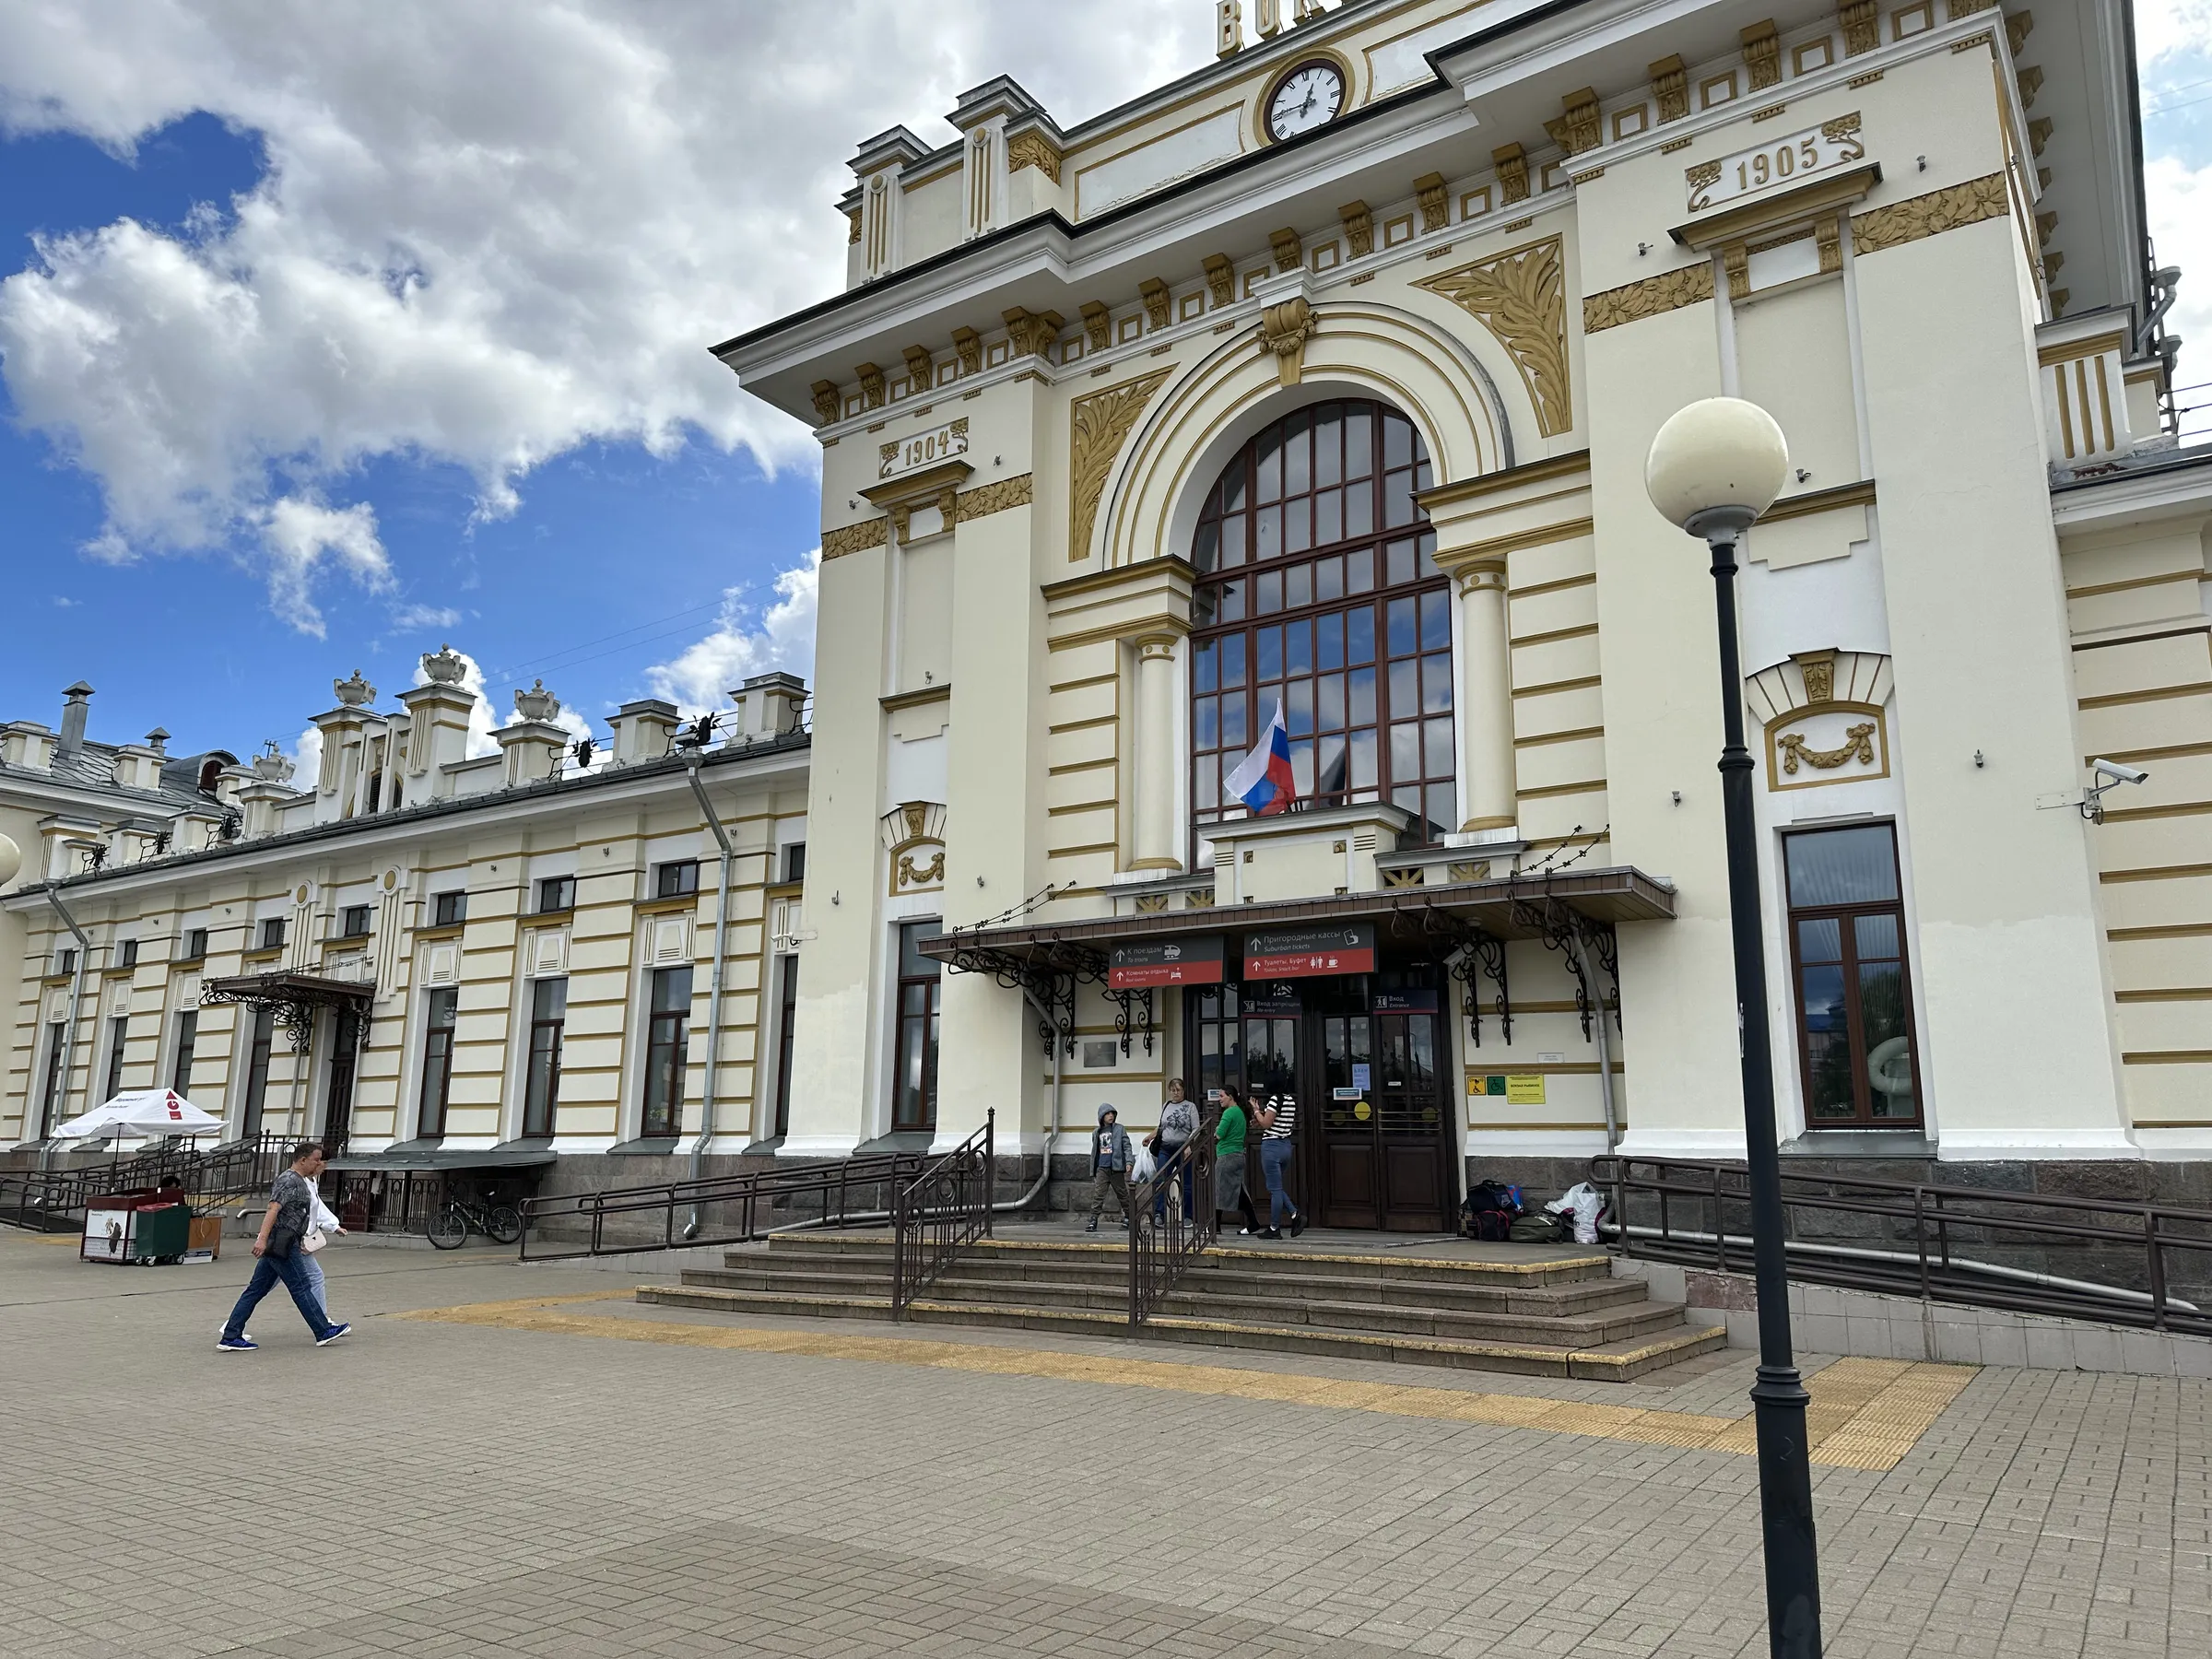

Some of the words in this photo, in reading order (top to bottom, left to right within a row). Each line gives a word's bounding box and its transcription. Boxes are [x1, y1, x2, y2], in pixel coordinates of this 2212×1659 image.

[1736, 135, 1818, 190] 1905
[905, 429, 950, 466] 1904
[1264, 933, 1316, 944] Пригородные
[1317, 931, 1341, 939] кассы
[1133, 947, 1162, 955] поездам
[1264, 959, 1288, 967] Туалеты,
[1289, 957, 1307, 965] Буфет
[1126, 969, 1150, 977] Комнаты
